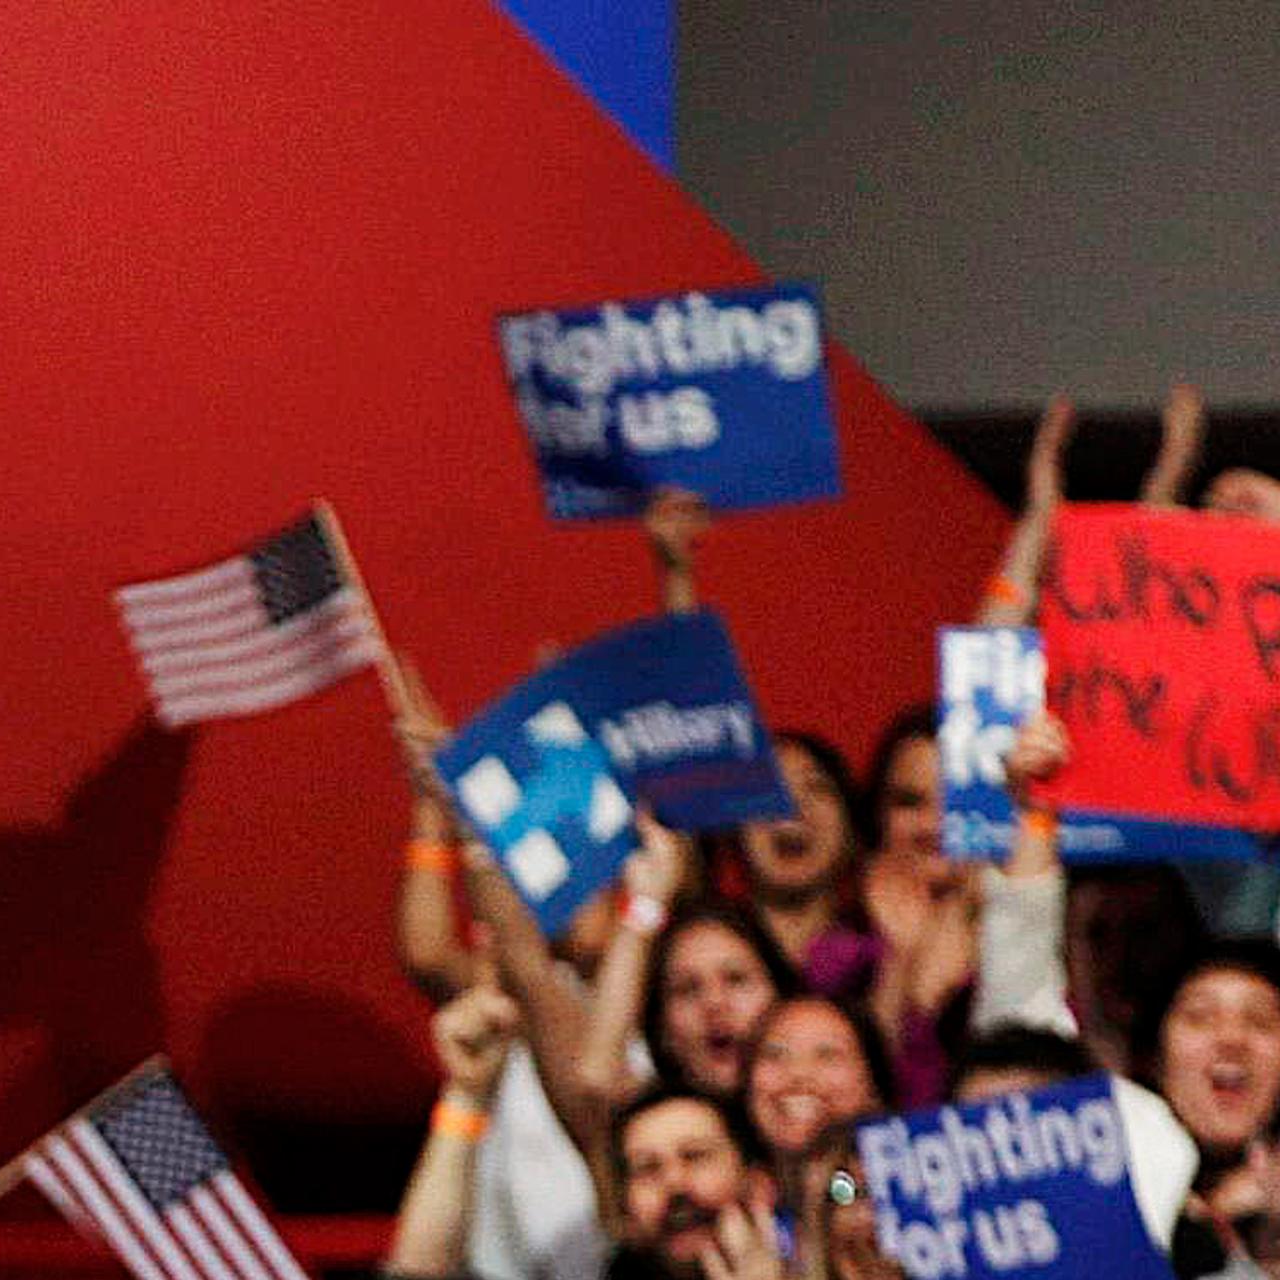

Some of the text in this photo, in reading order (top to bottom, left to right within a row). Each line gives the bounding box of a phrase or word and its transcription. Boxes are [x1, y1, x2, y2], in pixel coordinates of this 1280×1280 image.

[500, 292, 819, 396] Fighting
[621, 386, 721, 450] us
[856, 1092, 1124, 1216] Fighting
[973, 1198, 1061, 1270] us
